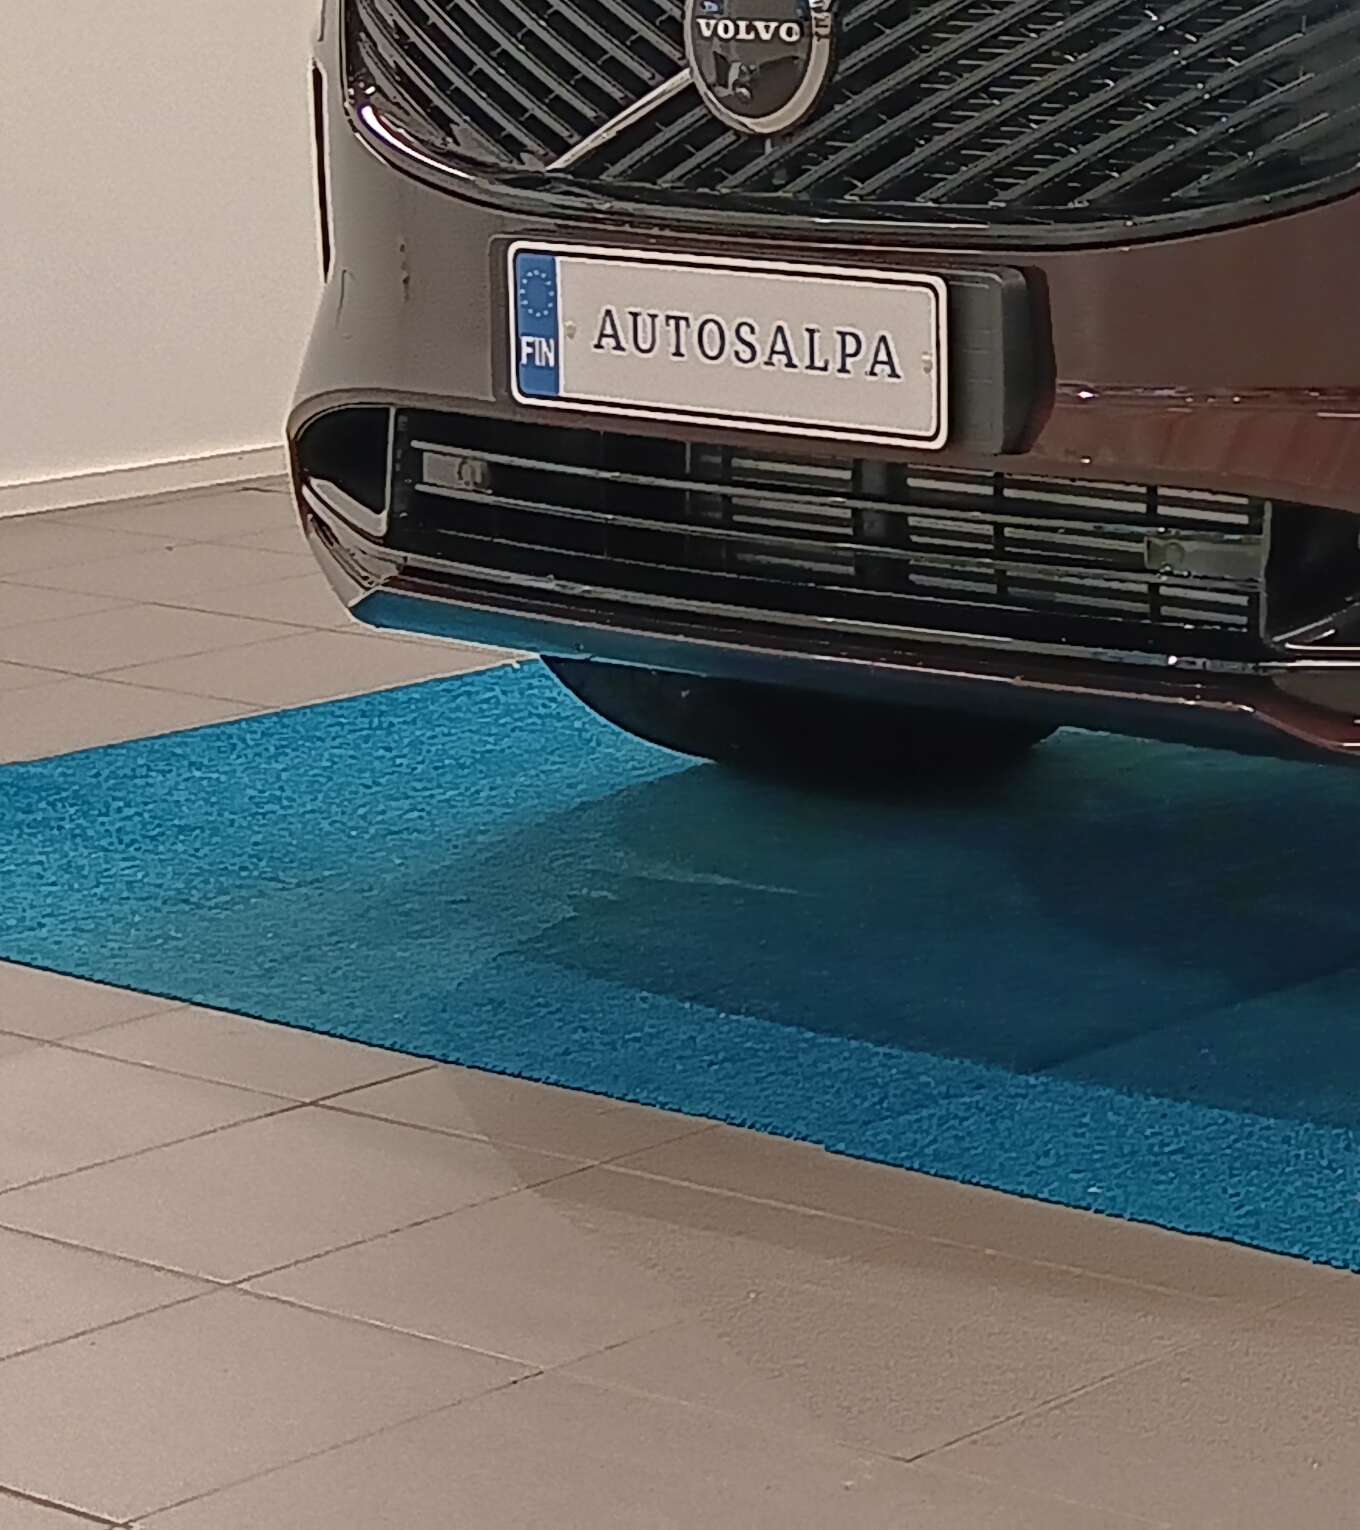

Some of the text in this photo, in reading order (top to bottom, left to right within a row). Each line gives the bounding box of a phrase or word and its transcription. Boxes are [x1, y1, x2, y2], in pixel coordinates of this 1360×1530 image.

[697, 18, 802, 43] VOLVO
[520, 335, 556, 368] FIN
[593, 307, 904, 380] AUTOSALPA
